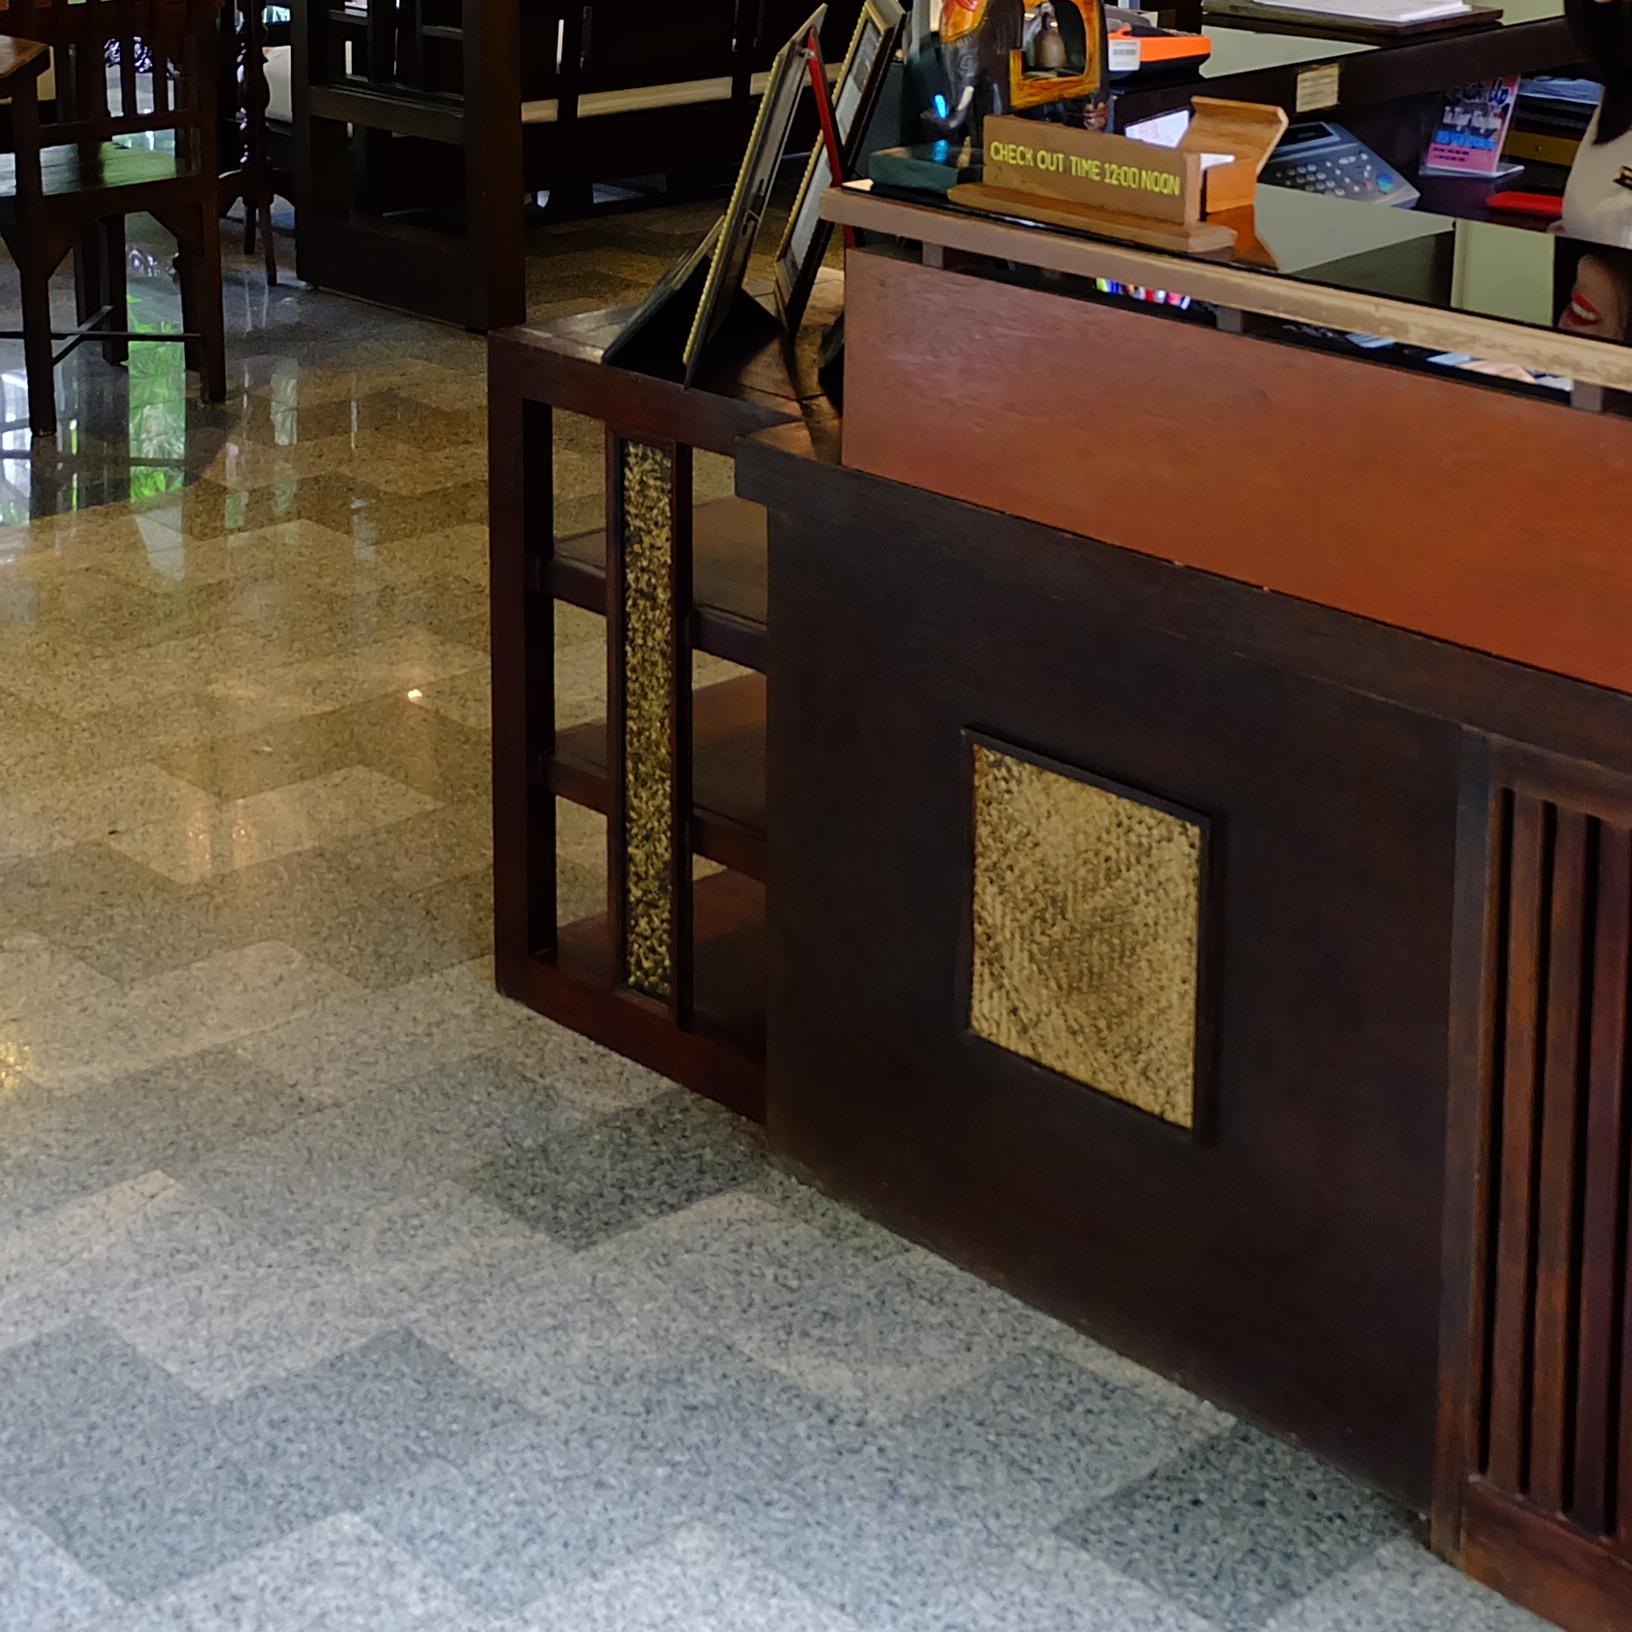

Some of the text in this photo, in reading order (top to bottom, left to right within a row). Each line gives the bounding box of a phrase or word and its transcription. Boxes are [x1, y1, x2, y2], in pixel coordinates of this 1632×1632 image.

[990, 141, 1034, 167] CHECK
[1037, 151, 1065, 172] OUT
[1070, 156, 1102, 180] TIME
[1141, 170, 1180, 196] NOON
